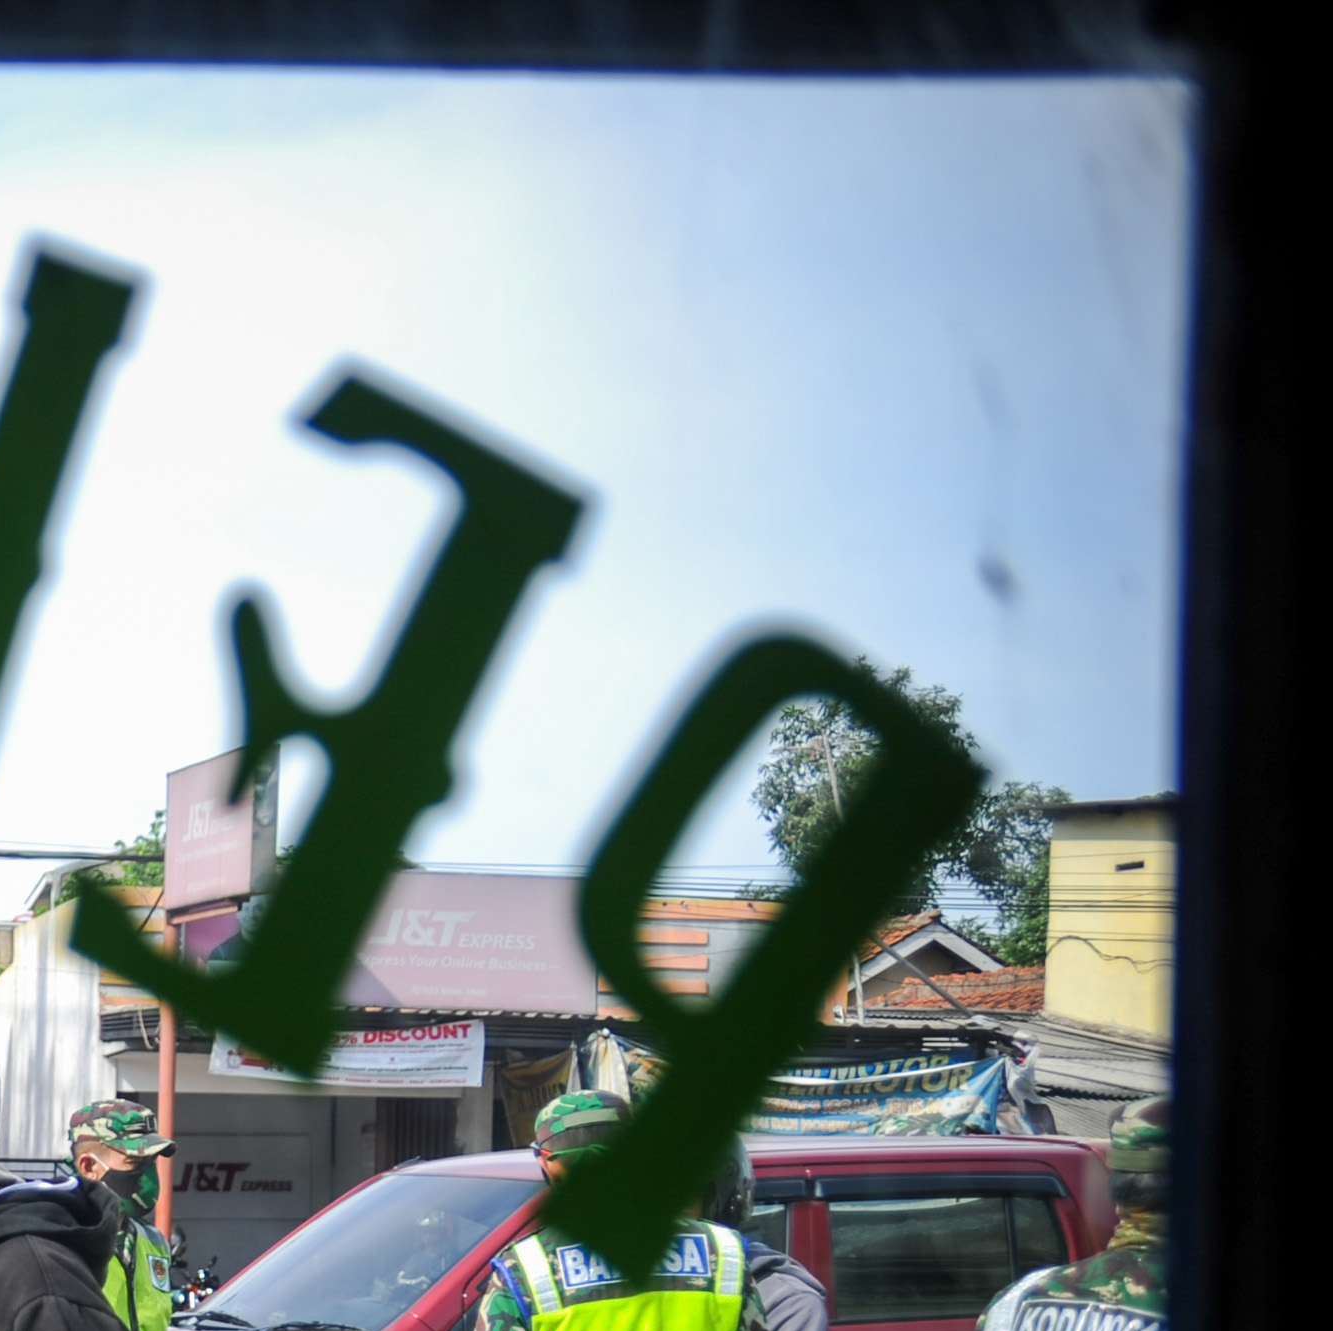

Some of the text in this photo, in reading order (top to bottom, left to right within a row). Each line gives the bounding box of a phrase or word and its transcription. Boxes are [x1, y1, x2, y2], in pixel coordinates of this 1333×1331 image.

[369, 909, 536, 950] J&T EXPRESS
[409, 954, 438, 967] Your
[441, 955, 486, 970] Online
[489, 957, 546, 972] Business
[363, 1023, 472, 1044] DISCOUNT
[172, 1162, 293, 1192] J&T EXPRESS
[563, 1238, 705, 1285] BASA
